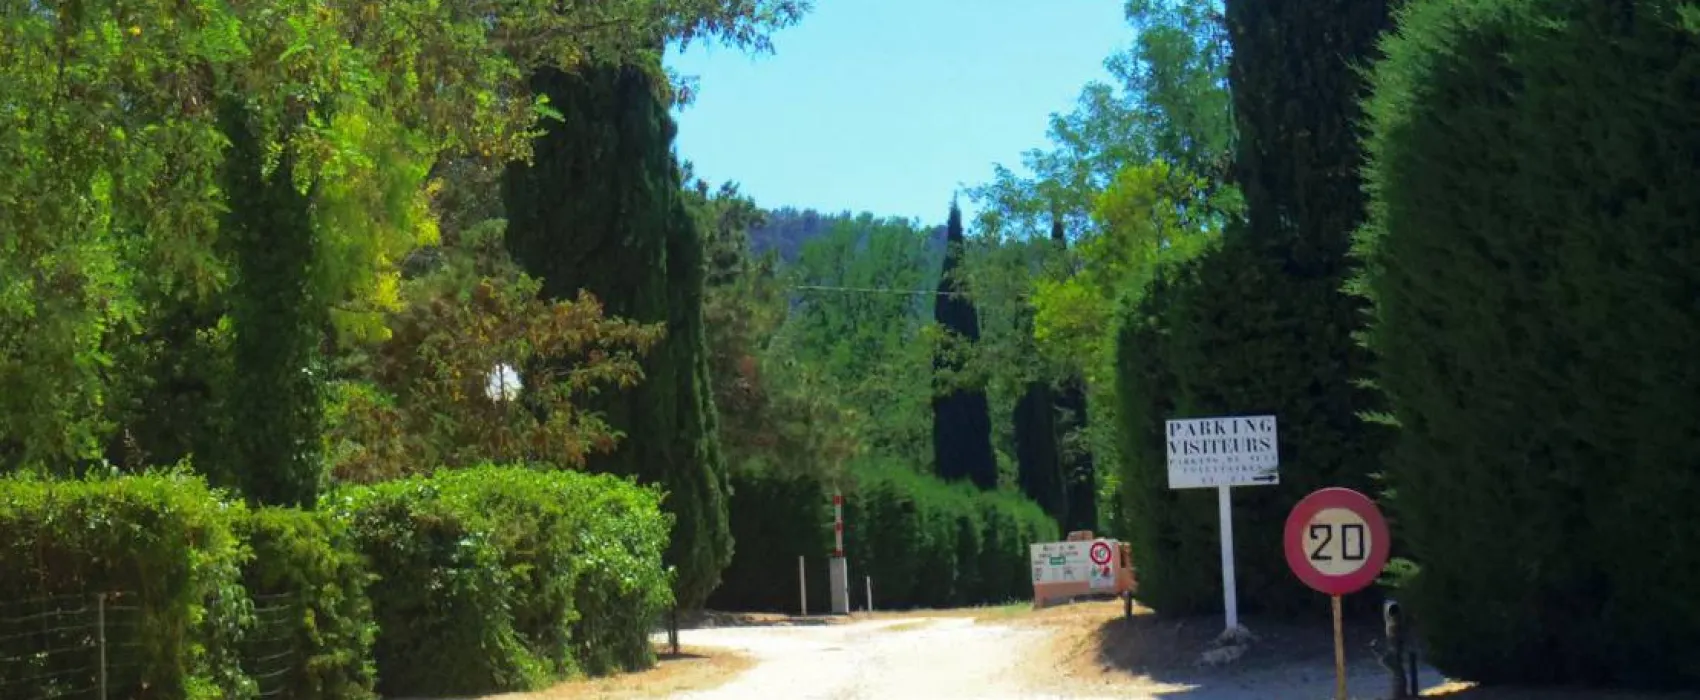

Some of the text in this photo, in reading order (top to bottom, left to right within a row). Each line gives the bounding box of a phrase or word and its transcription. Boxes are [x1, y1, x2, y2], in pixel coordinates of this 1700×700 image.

[1169, 419, 1273, 437] PARKING
[1169, 438, 1271, 455] VISITEURS
[1310, 524, 1364, 560] 20
